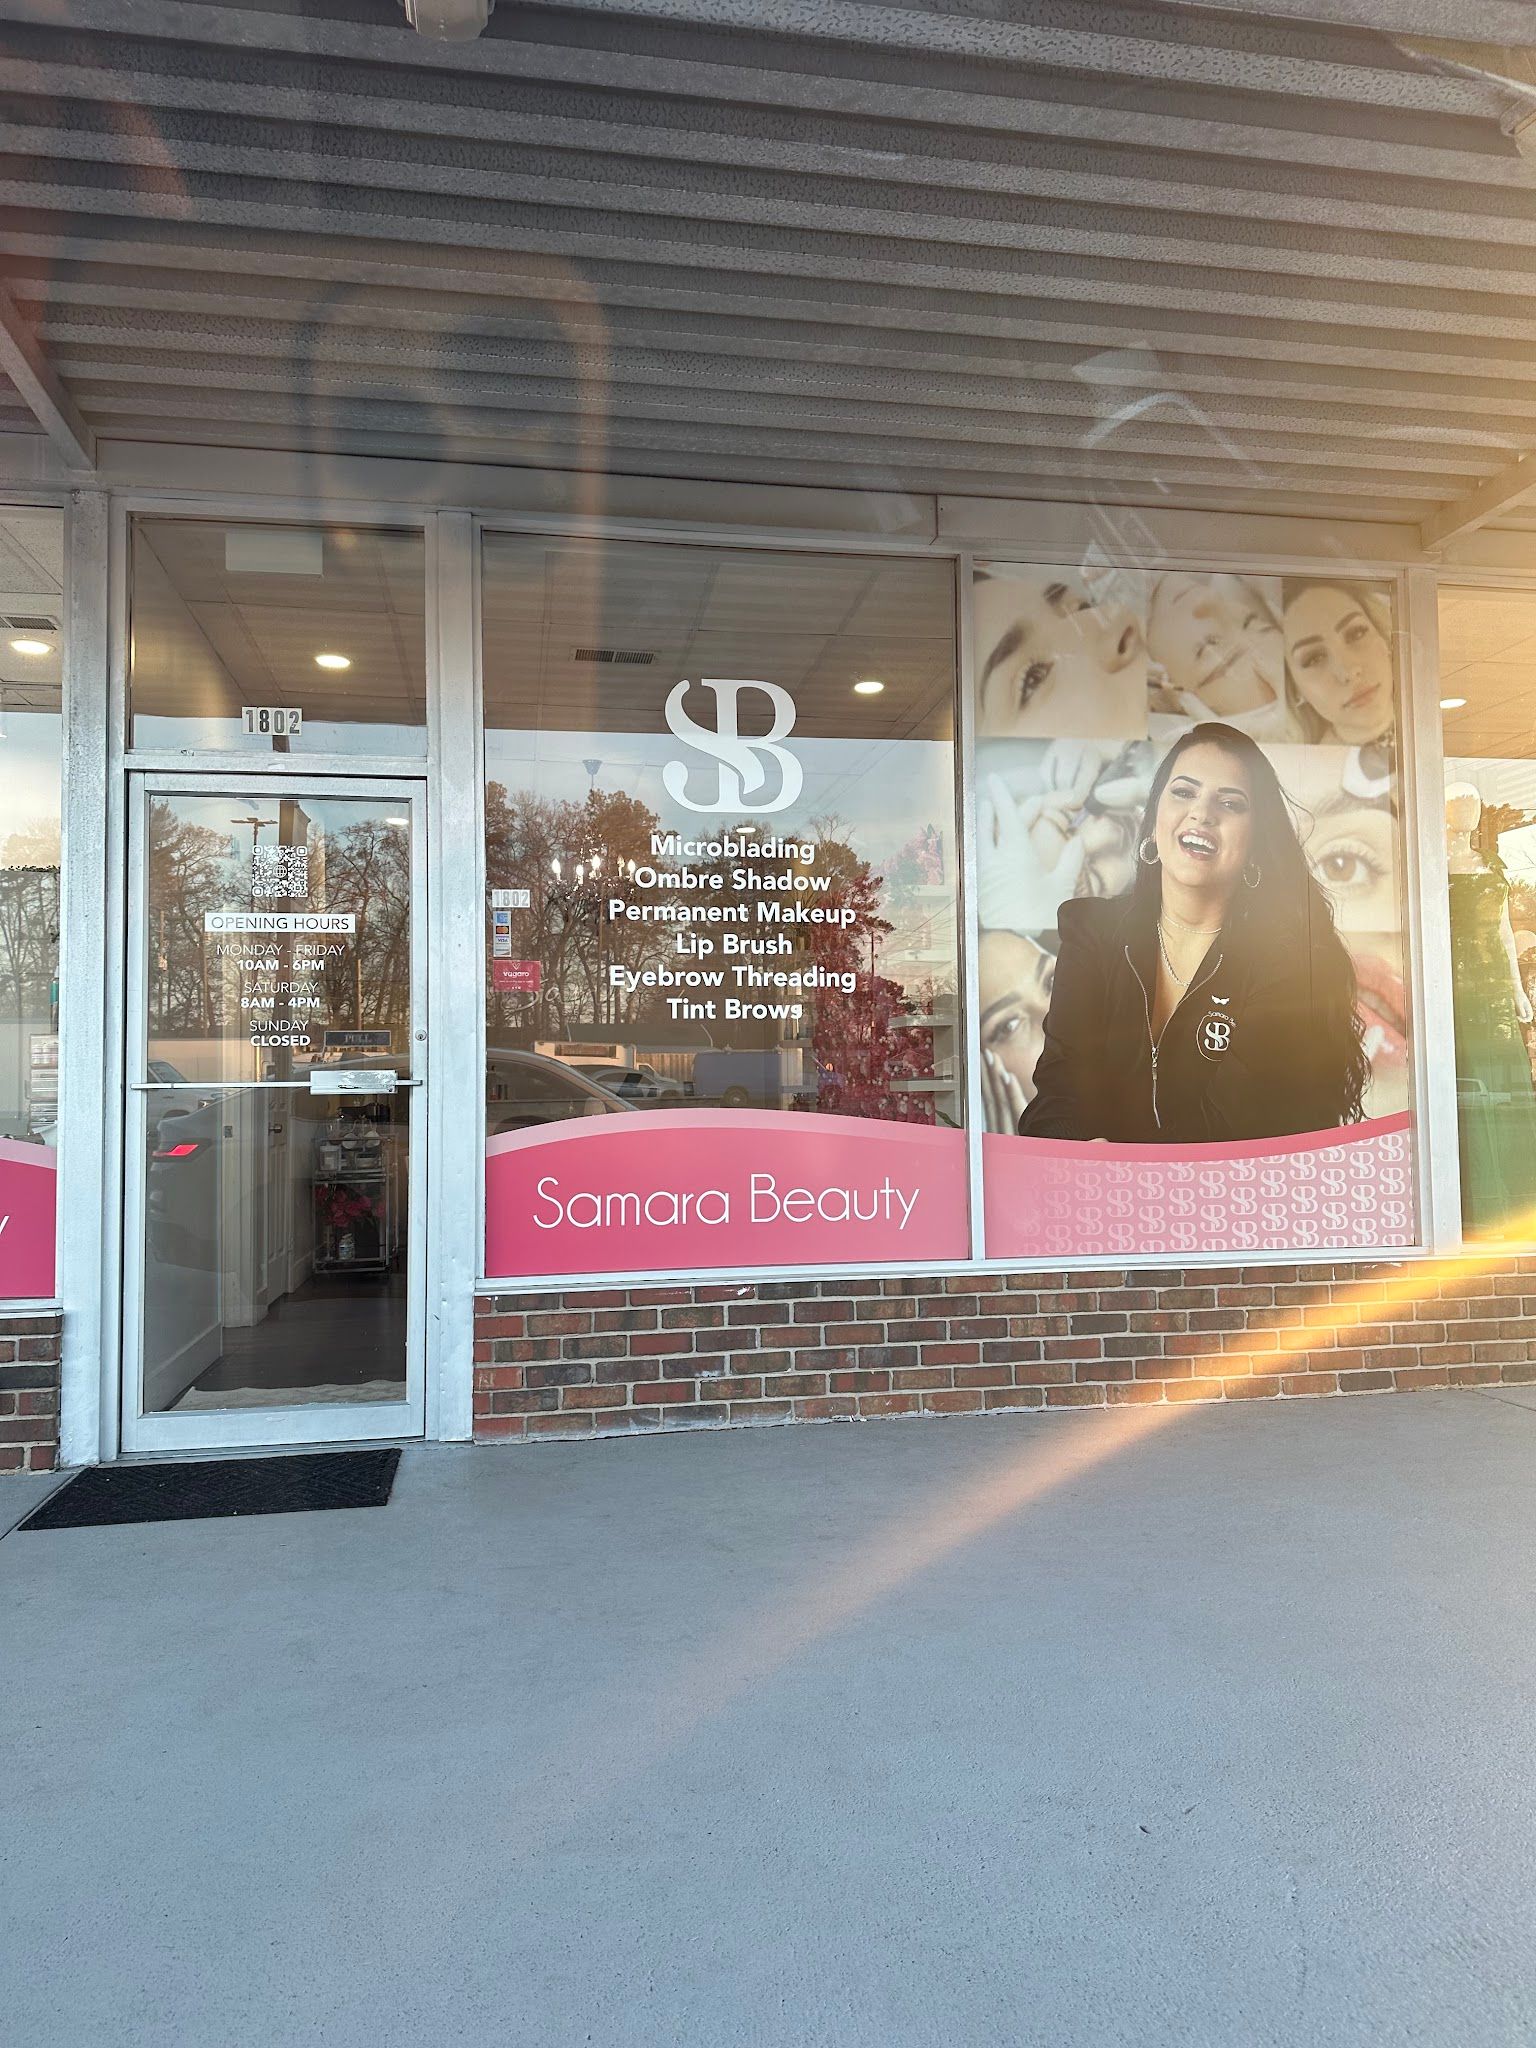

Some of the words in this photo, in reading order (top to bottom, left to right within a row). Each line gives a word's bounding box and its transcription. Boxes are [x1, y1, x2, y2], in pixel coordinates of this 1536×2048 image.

[245, 709, 301, 734] 1802
[651, 834, 815, 864] Microblading
[635, 867, 724, 889] Ombre
[732, 868, 831, 891] Shadow
[495, 890, 529, 907] 1802
[211, 916, 288, 930] OPENING
[294, 917, 349, 930] HOURS
[609, 900, 749, 921] Permanent
[757, 901, 856, 928] Makeup
[216, 944, 283, 956] MONDAY
[296, 944, 345, 956] FRIDAY
[676, 933, 714, 959] Lip
[723, 933, 792, 954] Brush
[238, 959, 279, 971] 10AM
[292, 959, 325, 971] 6PM
[244, 982, 318, 994] SATURDAY
[609, 965, 724, 992] Eyebrow
[732, 966, 856, 993] Threading
[240, 997, 275, 1009] 8AM
[287, 997, 320, 1009] 4PM
[667, 998, 716, 1020] Tint
[725, 999, 803, 1020] Brows
[249, 1020, 309, 1032] SUNDAY
[250, 1035, 311, 1047] CLOSED
[533, 1176, 729, 1229] Samara
[750, 1173, 920, 1230] Beauty
